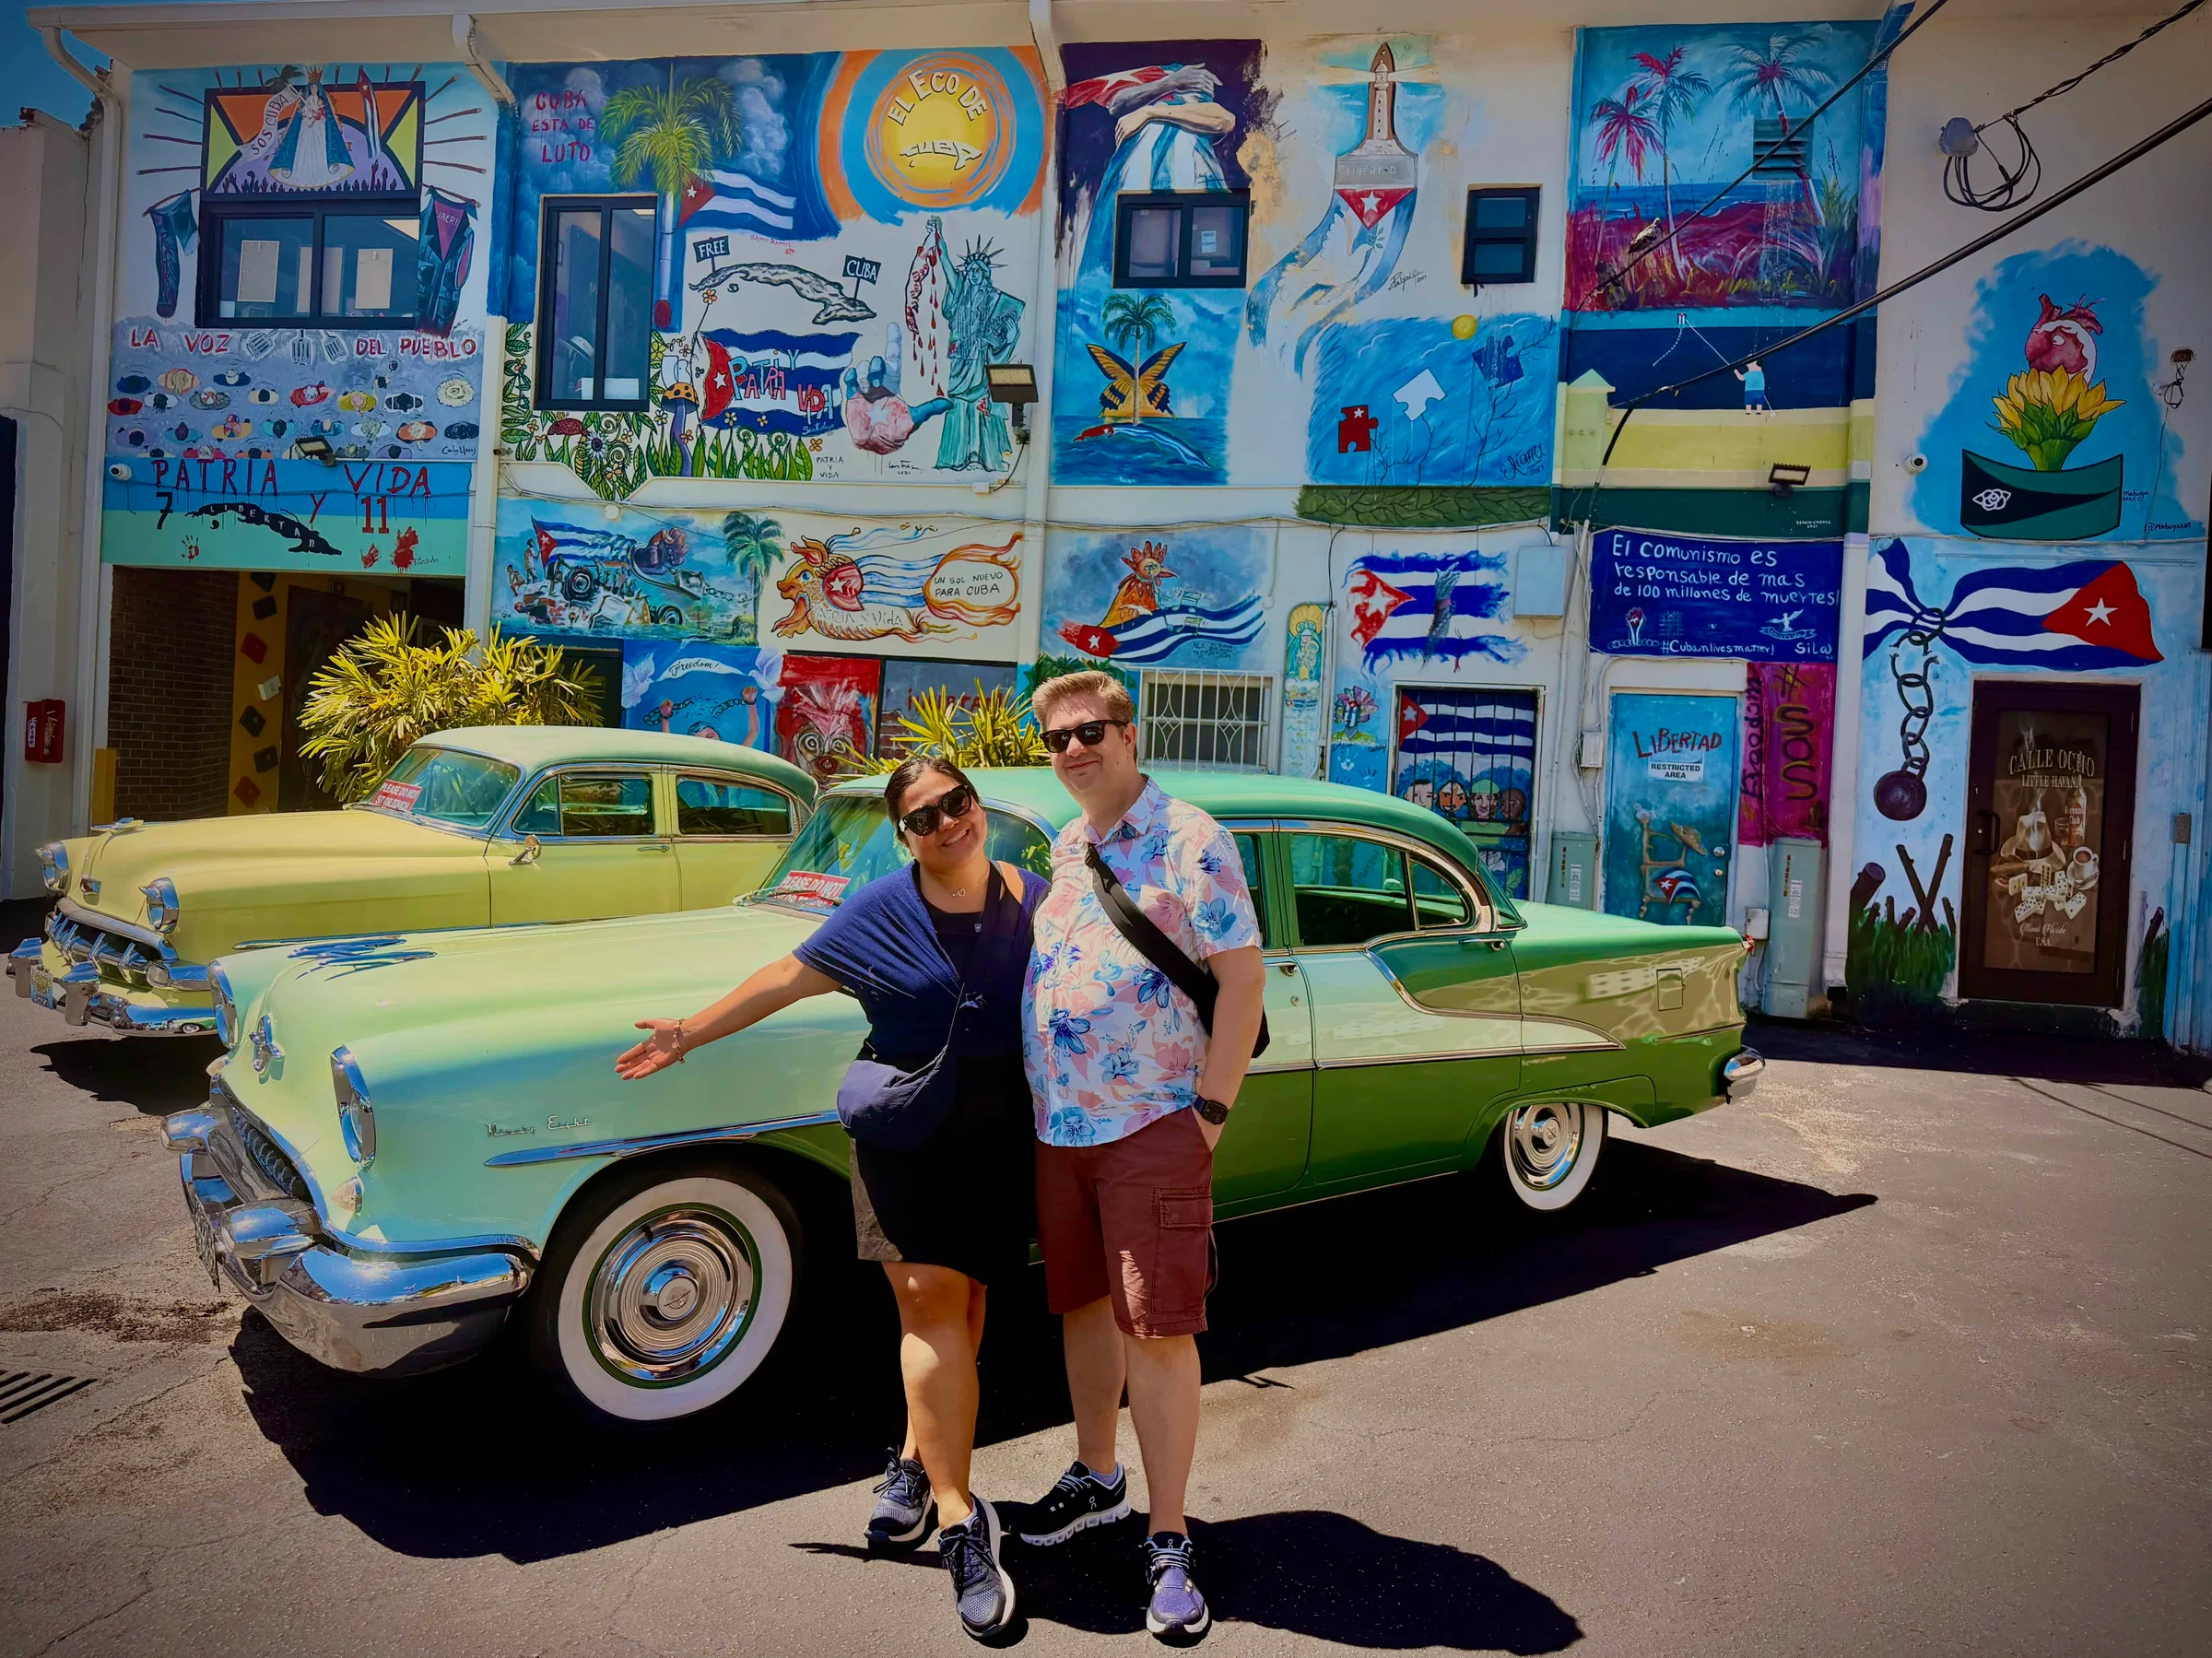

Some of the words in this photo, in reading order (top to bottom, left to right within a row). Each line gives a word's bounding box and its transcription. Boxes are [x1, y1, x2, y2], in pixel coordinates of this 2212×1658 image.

[536, 90, 587, 110] CUBA
[888, 96, 915, 126] EL
[908, 69, 959, 101] ECO
[958, 85, 988, 122] DE
[532, 118, 570, 132] ESTA
[578, 117, 594, 129] DE
[251, 129, 273, 155] SOS
[542, 140, 591, 162] LUTO
[697, 239, 726, 259] FREE
[846, 259, 877, 280] CUBA
[131, 328, 159, 349] LA
[184, 334, 230, 353] VOZ
[355, 337, 387, 356] DEL
[400, 337, 477, 358] PUEBLO
[787, 348, 800, 370] Y
[151, 459, 278, 495] PATRIA
[310, 492, 327, 524] Y
[344, 463, 431, 496] VIDA
[155, 491, 174, 530] 7
[360, 495, 390, 535] 11
[1612, 534, 1630, 557] El
[1750, 549, 1778, 567] es
[934, 576, 946, 584] UN
[972, 571, 1004, 582] NUEVO
[1614, 561, 1723, 585] responsable
[1728, 570, 1750, 586] de
[1759, 572, 1806, 588] mas
[935, 587, 960, 597] PARA
[966, 583, 1001, 595] CUBA
[1614, 582, 1632, 596] de
[1637, 584, 1660, 598] 100
[1665, 585, 1731, 601] millones
[1735, 589, 1752, 602] de
[1632, 727, 1723, 758] LIBERTAD
[1651, 763, 1700, 772] RESTRICTED
[2009, 749, 2053, 775] CALLE
[2058, 749, 2095, 777] OCHO
[1664, 771, 1687, 780] AREA
[2021, 774, 2050, 788] LITTLE
[2052, 774, 2083, 789] HAVANA
[380, 782, 401, 795] PLEASE
[398, 786, 408, 797] DO
[407, 788, 421, 799] NOT
[375, 794, 384, 805] SIT
[384, 797, 394, 806] OR
[394, 799, 411, 811] TOUCH
[781, 876, 812, 890] PLEASE
[809, 878, 825, 893] DO
[821, 881, 845, 898] NOT
